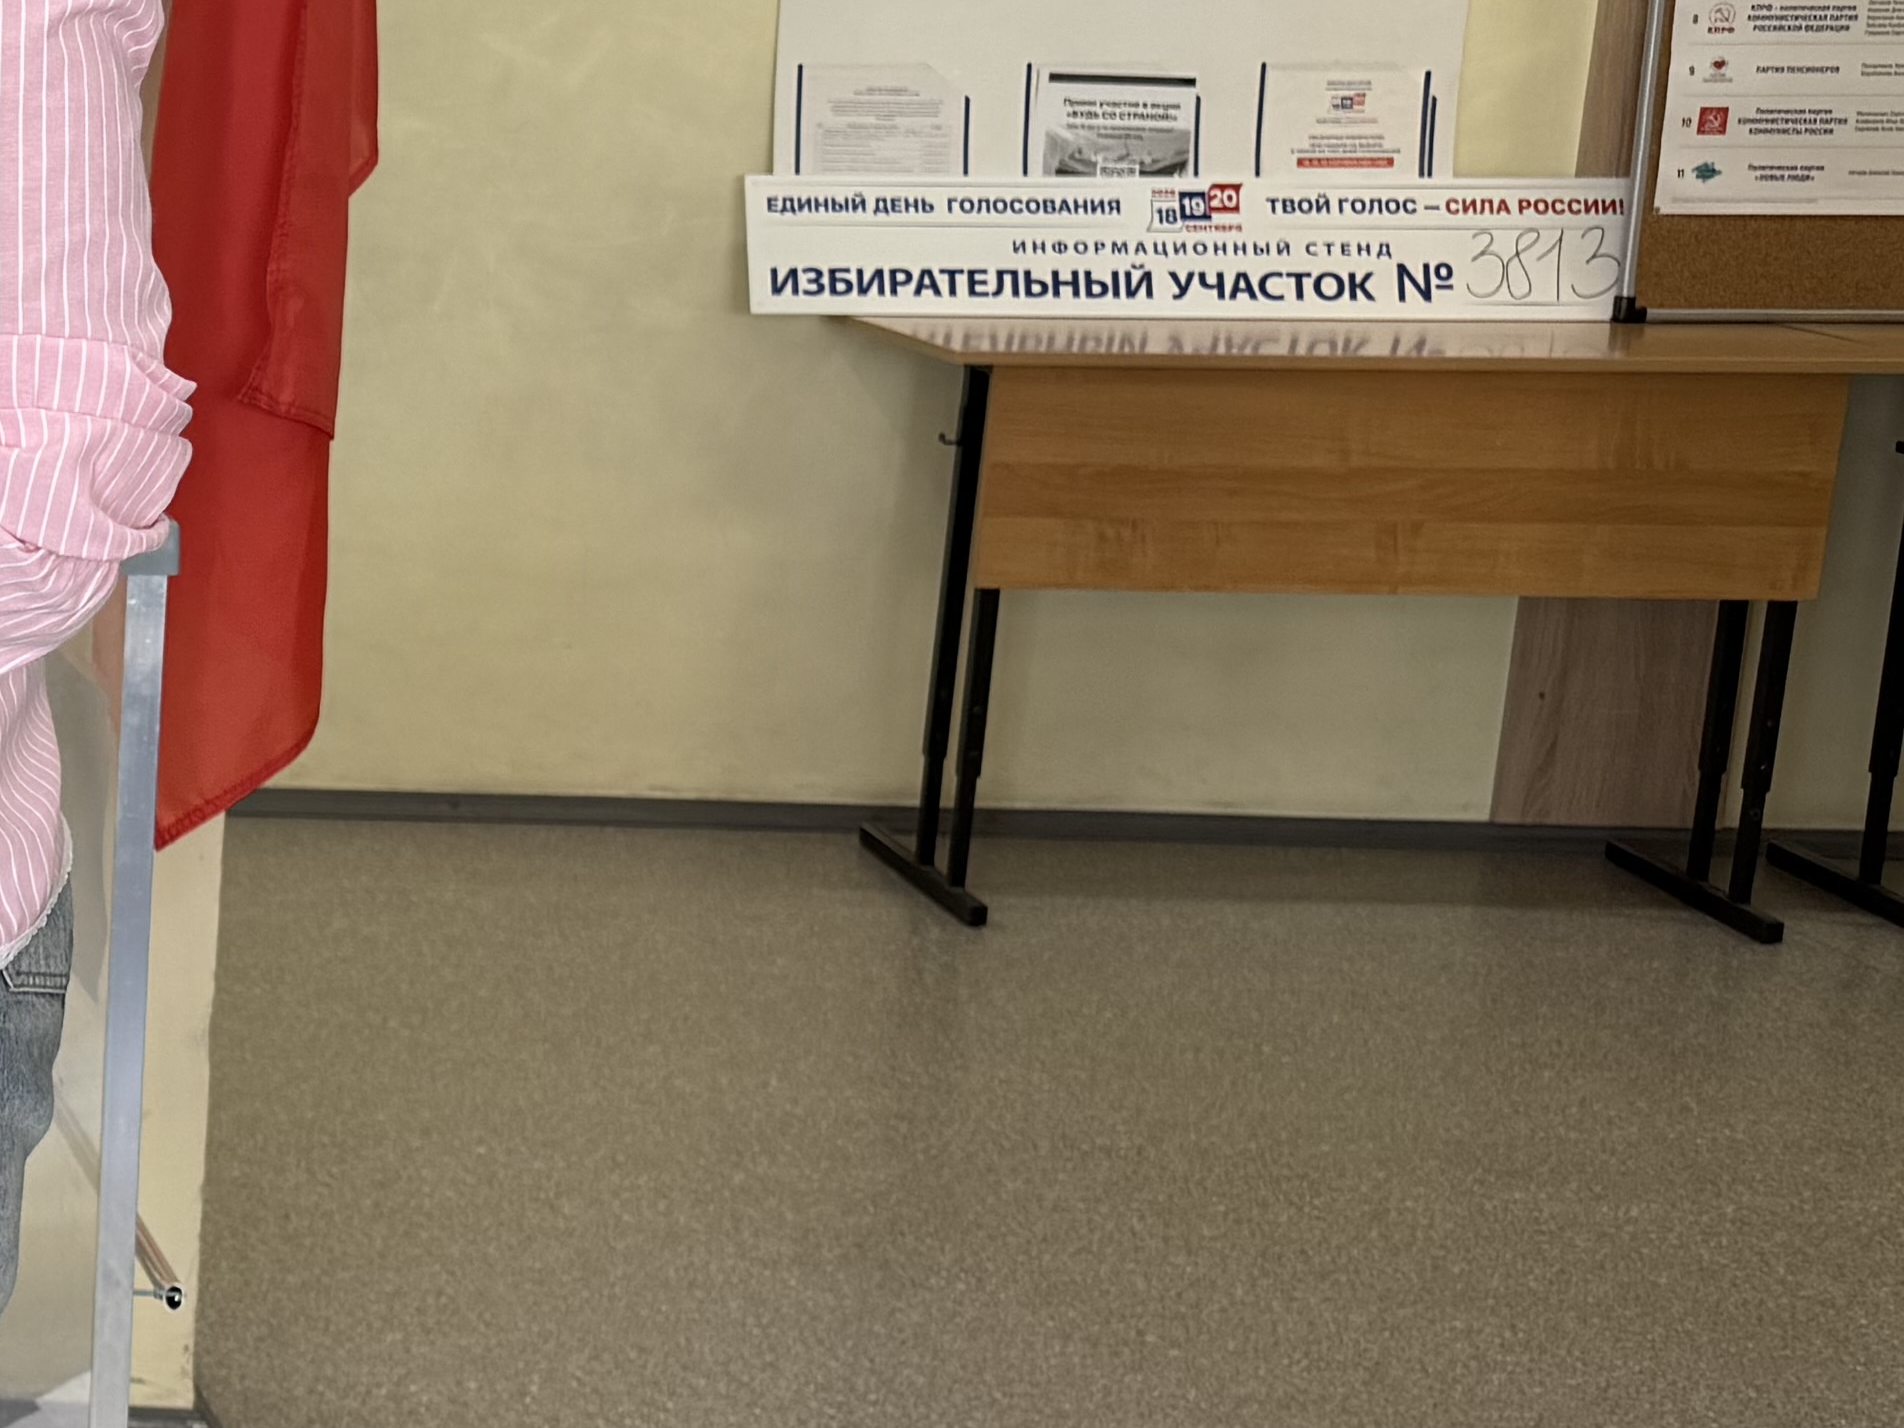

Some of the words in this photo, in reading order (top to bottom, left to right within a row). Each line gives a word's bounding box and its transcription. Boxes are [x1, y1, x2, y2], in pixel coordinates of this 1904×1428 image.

[767, 191, 866, 214] ЕДИНЫЙ
[873, 196, 934, 217] ДЕНЬ
[947, 196, 1121, 216] ГОЛОСОВАНИЯ
[1157, 207, 1177, 226] 18
[1181, 194, 1206, 218] 19
[1209, 188, 1237, 208] 20
[1266, 193, 1330, 216] ТВОЙ
[1338, 197, 1417, 216] ГОЛОС
[1446, 197, 1512, 216] СИЛА
[1518, 197, 1625, 216] РОССИИ!
[1012, 238, 1291, 259] ИНФОРМАЦИОННЫЙ
[1306, 241, 1393, 260] СТЕНД
[1466, 226, 1621, 301] 3813
[769, 264, 1154, 300] ИЗБИРАТЕЛЬНЫЙ
[1167, 270, 1377, 302] УЧАСТОК
[1397, 262, 1454, 303] №
